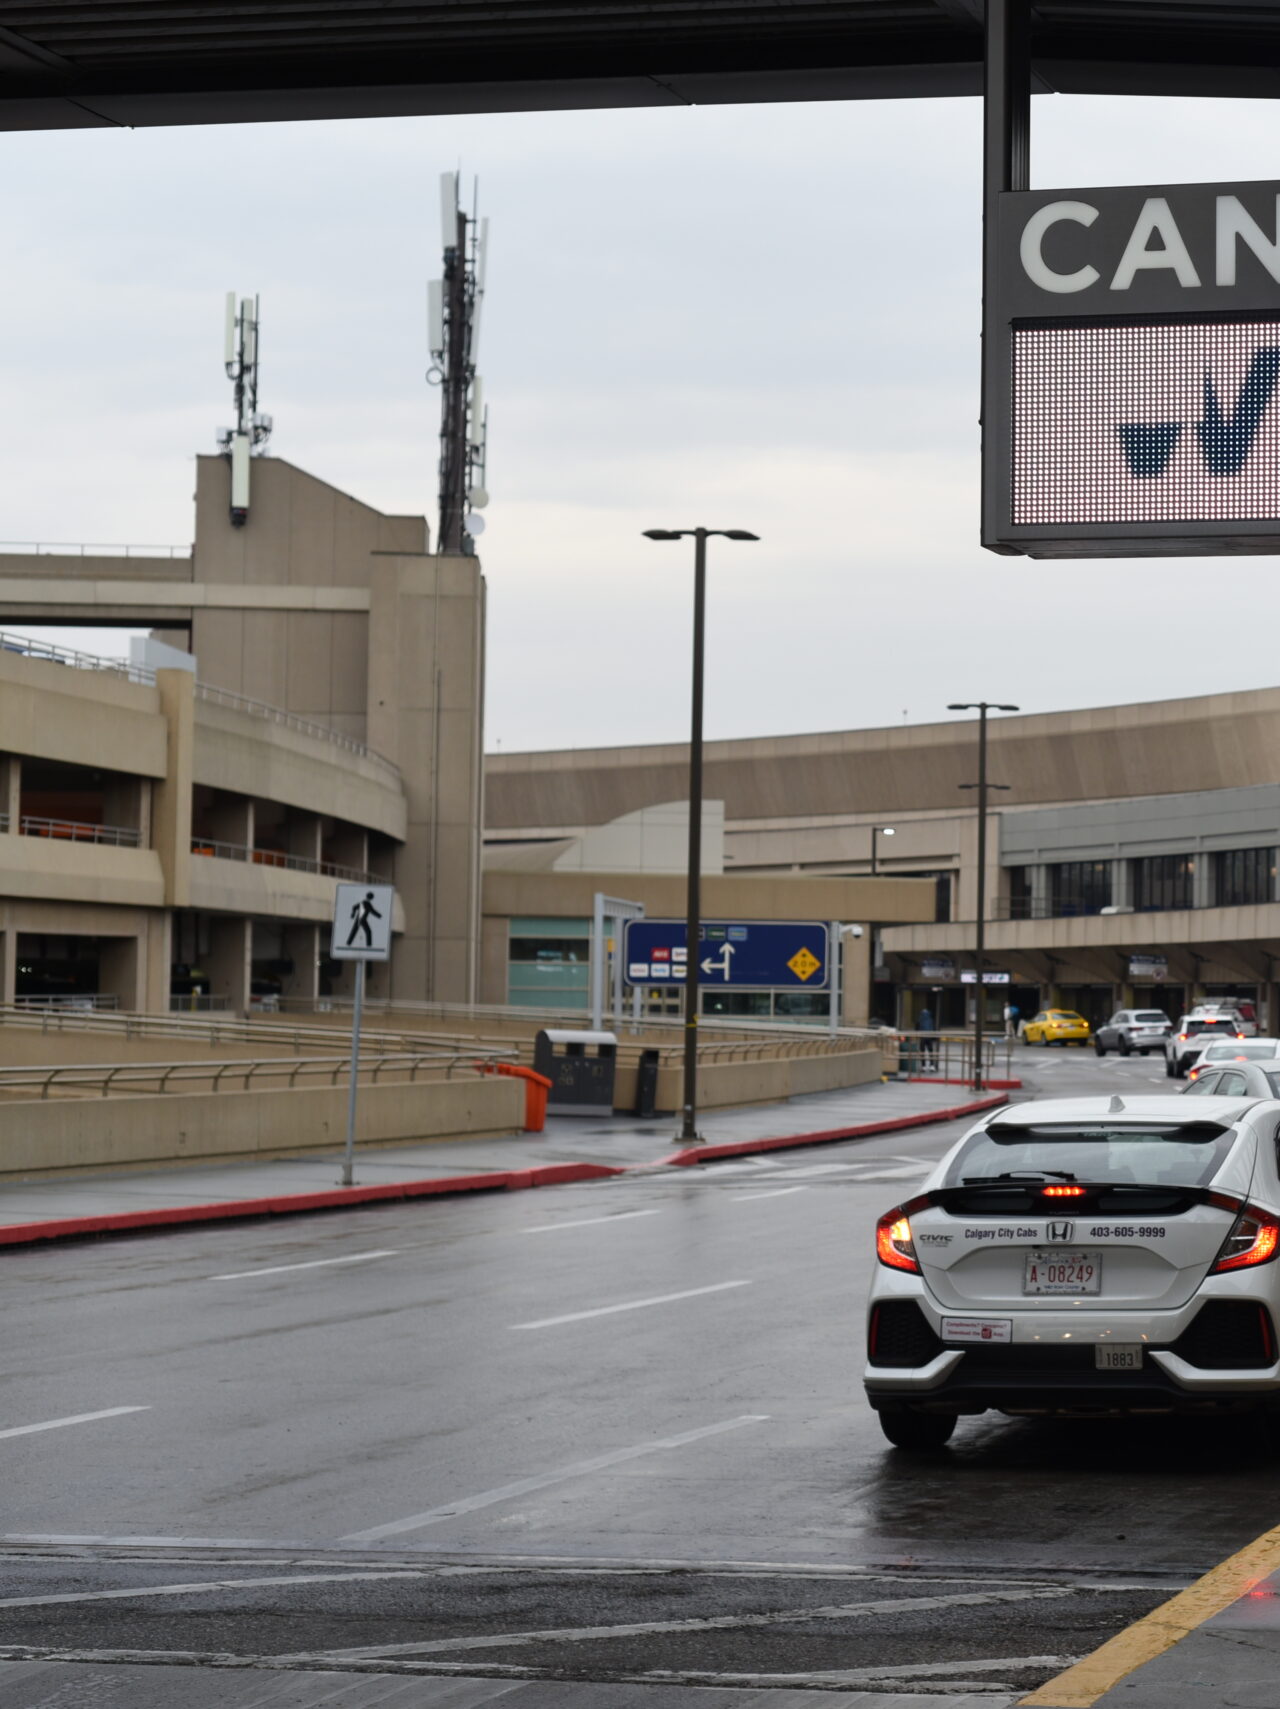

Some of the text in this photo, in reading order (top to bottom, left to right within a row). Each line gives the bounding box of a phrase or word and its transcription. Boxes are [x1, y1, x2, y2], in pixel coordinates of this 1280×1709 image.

[919, 1234, 954, 1242] CIVIC
[965, 1228, 1037, 1240] Calgary City Cabs
[1090, 1227, 1166, 1238] 403-605-9999
[1030, 1265, 1093, 1283] A-08249
[1106, 1353, 1134, 1367] 1883
